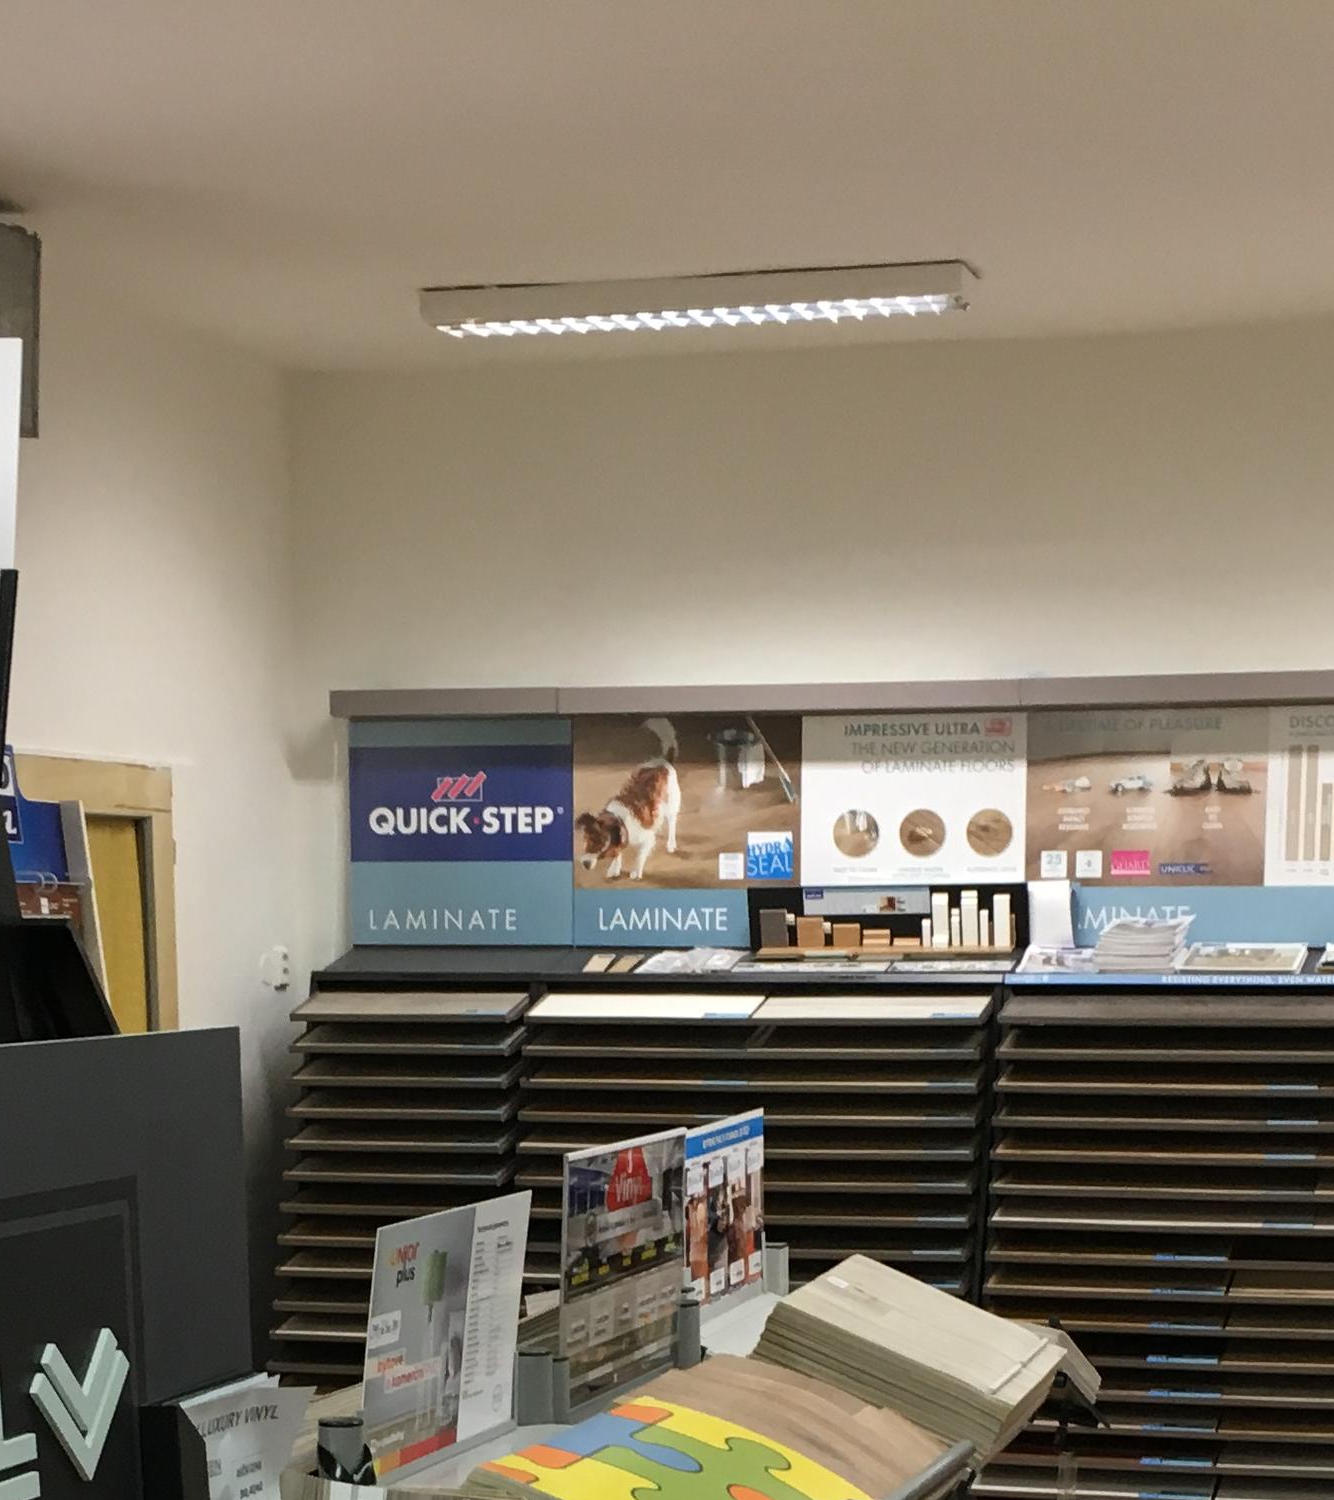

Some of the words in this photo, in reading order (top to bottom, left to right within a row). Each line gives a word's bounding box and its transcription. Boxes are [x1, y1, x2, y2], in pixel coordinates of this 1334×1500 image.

[844, 723, 931, 737] IMPRESSIVE
[935, 722, 980, 735] ULTRA
[853, 742, 876, 755] THE
[882, 742, 916, 753] NEW
[921, 740, 1015, 754] GENERATION
[747, 854, 793, 876] SEAL
[370, 908, 517, 931] LAMINATE
[599, 907, 728, 931] LAMINATE
